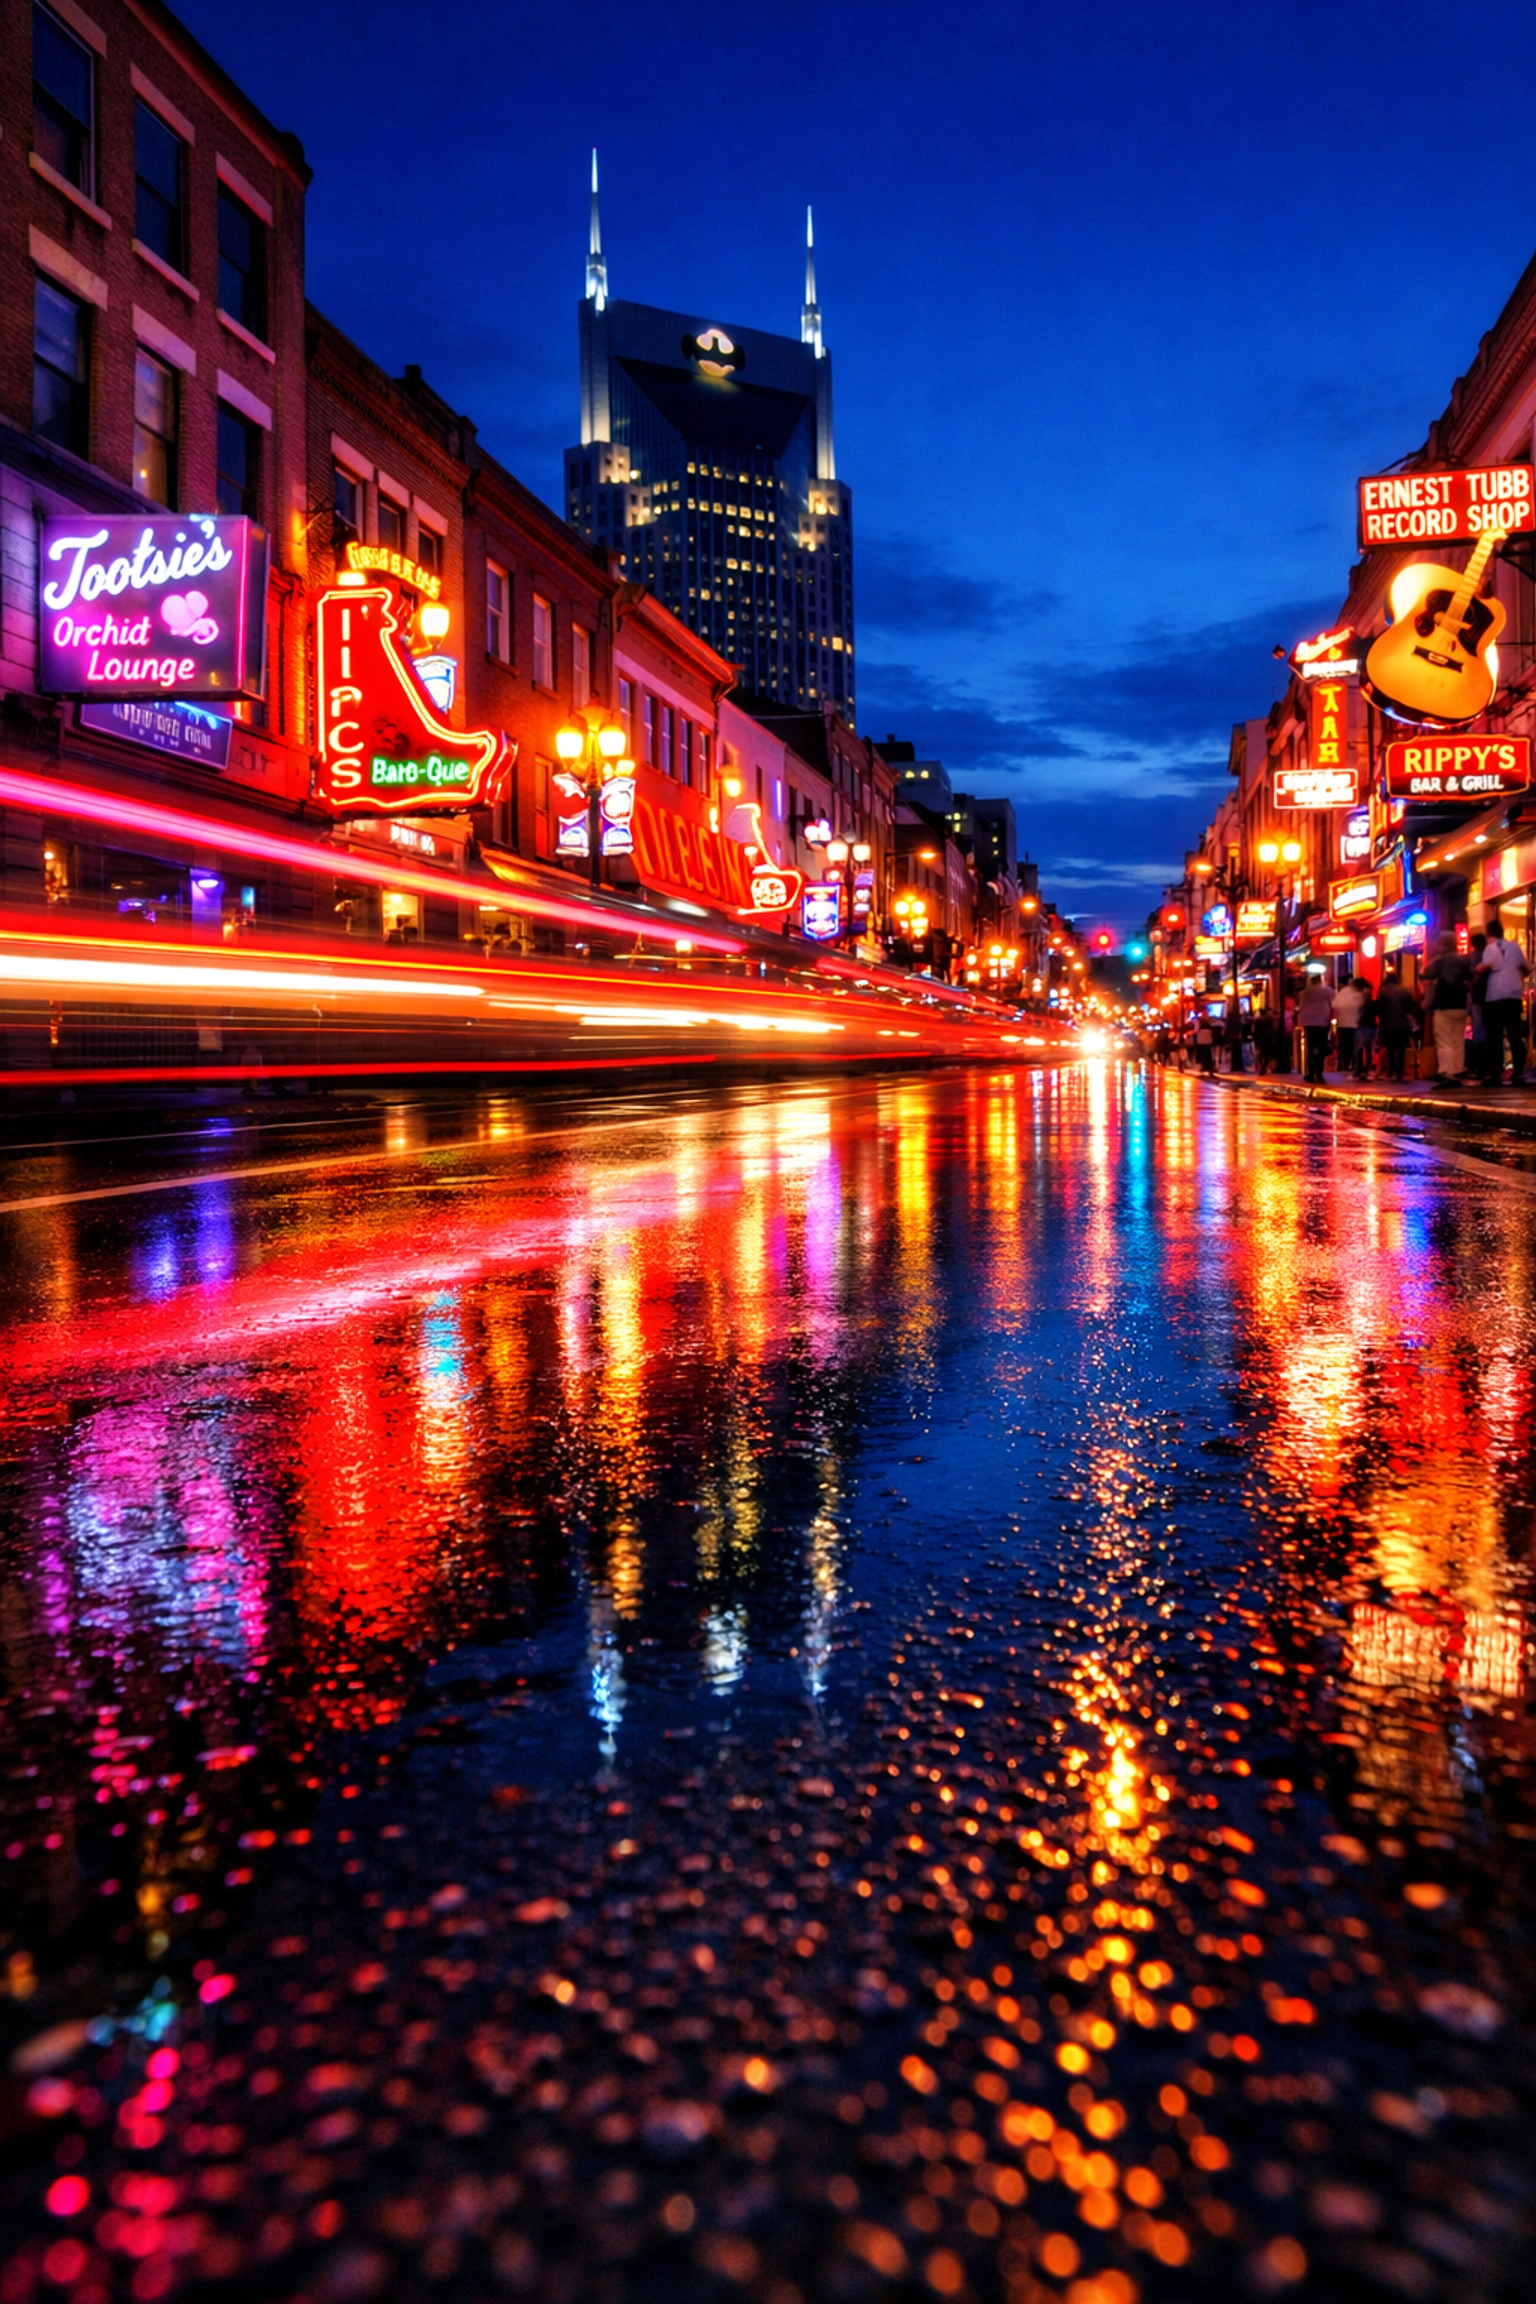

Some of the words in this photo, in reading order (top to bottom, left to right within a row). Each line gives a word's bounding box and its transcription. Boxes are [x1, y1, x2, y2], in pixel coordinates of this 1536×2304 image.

[1364, 476, 1453, 511] ERNEST
[1465, 469, 1530, 502] TUBB
[1367, 508, 1457, 540] RECORD
[1467, 500, 1530, 533] SHOP
[44, 519, 232, 610] Tootsie's
[53, 614, 151, 647] Orchid
[87, 650, 195, 687] Lounge
[1404, 744, 1516, 773] RIPPY'S
[1410, 777, 1442, 793] BAR
[1445, 775, 1459, 792] &
[1461, 774, 1505, 791] GRILL
